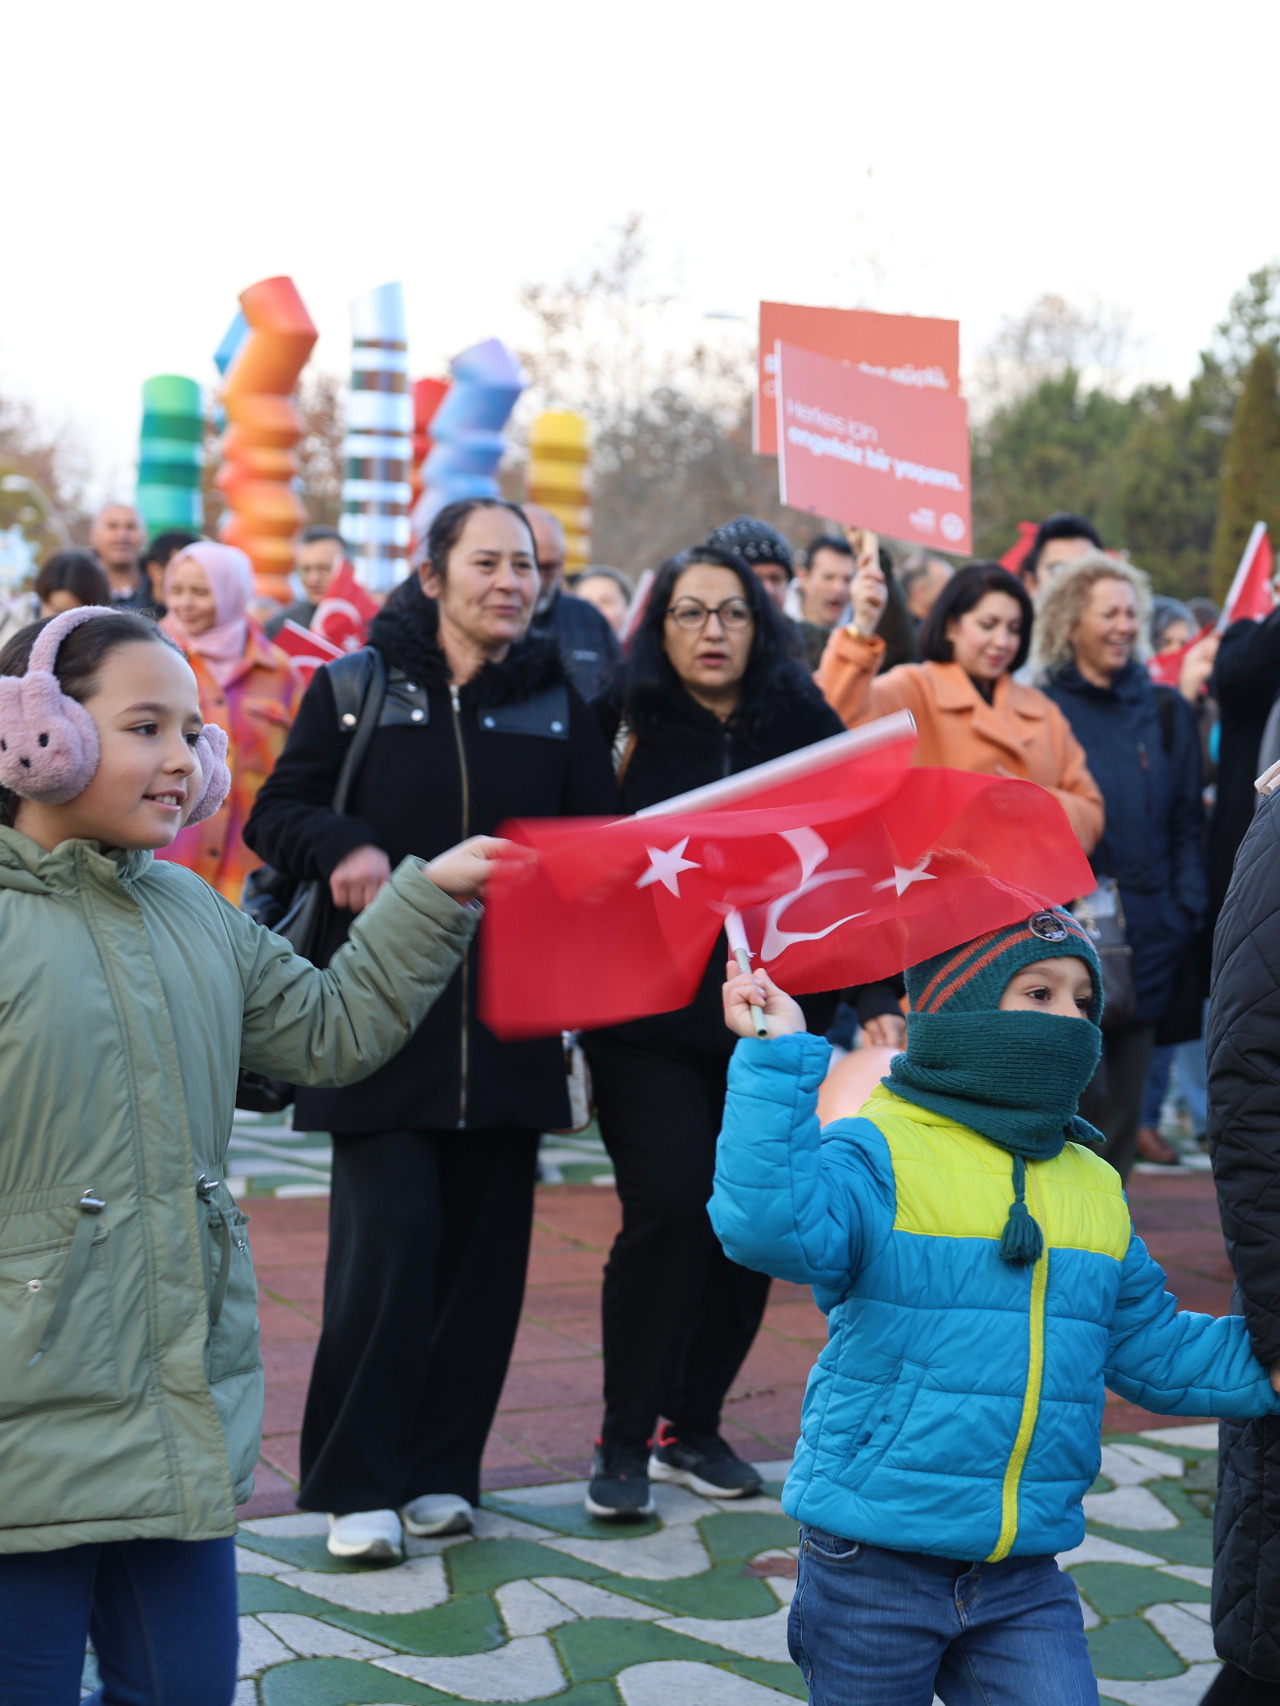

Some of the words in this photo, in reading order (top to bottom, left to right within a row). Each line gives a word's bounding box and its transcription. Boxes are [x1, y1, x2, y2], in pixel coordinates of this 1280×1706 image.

[786, 396, 847, 435] Herkes
[787, 425, 864, 465] engelsiz
[865, 446, 891, 473] bir
[891, 457, 964, 492] yaşam.
